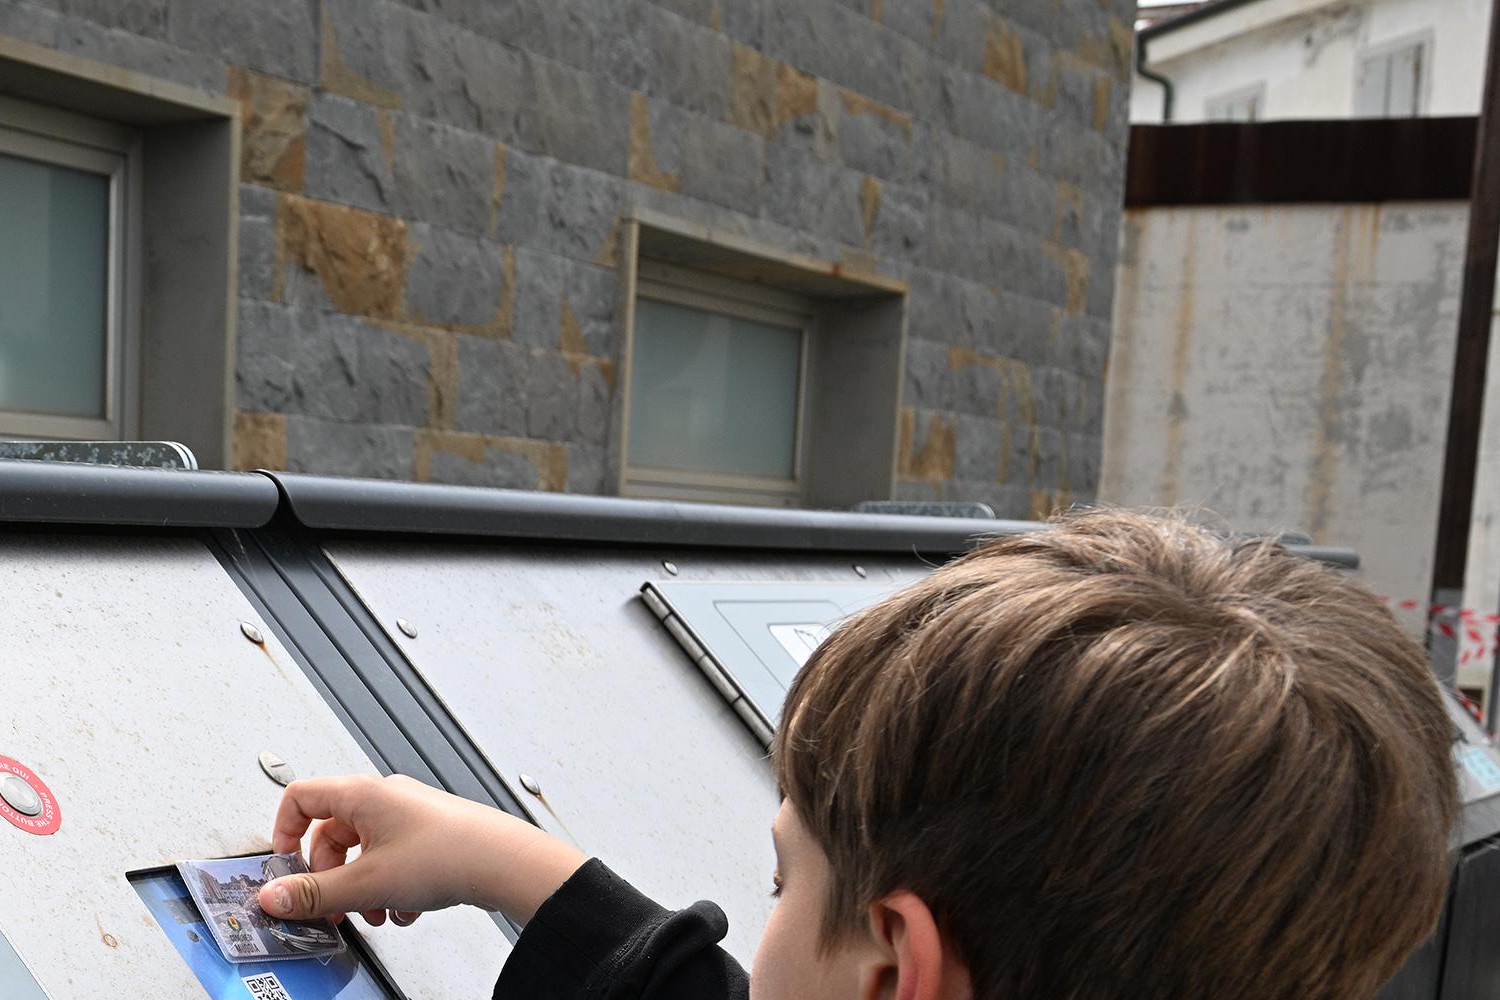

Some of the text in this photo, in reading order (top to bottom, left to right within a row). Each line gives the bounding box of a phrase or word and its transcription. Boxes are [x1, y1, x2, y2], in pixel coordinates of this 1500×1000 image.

[12, 766, 30, 780] QUI
[40, 792, 54, 820] PRESS
[34, 817, 51, 828] THE
